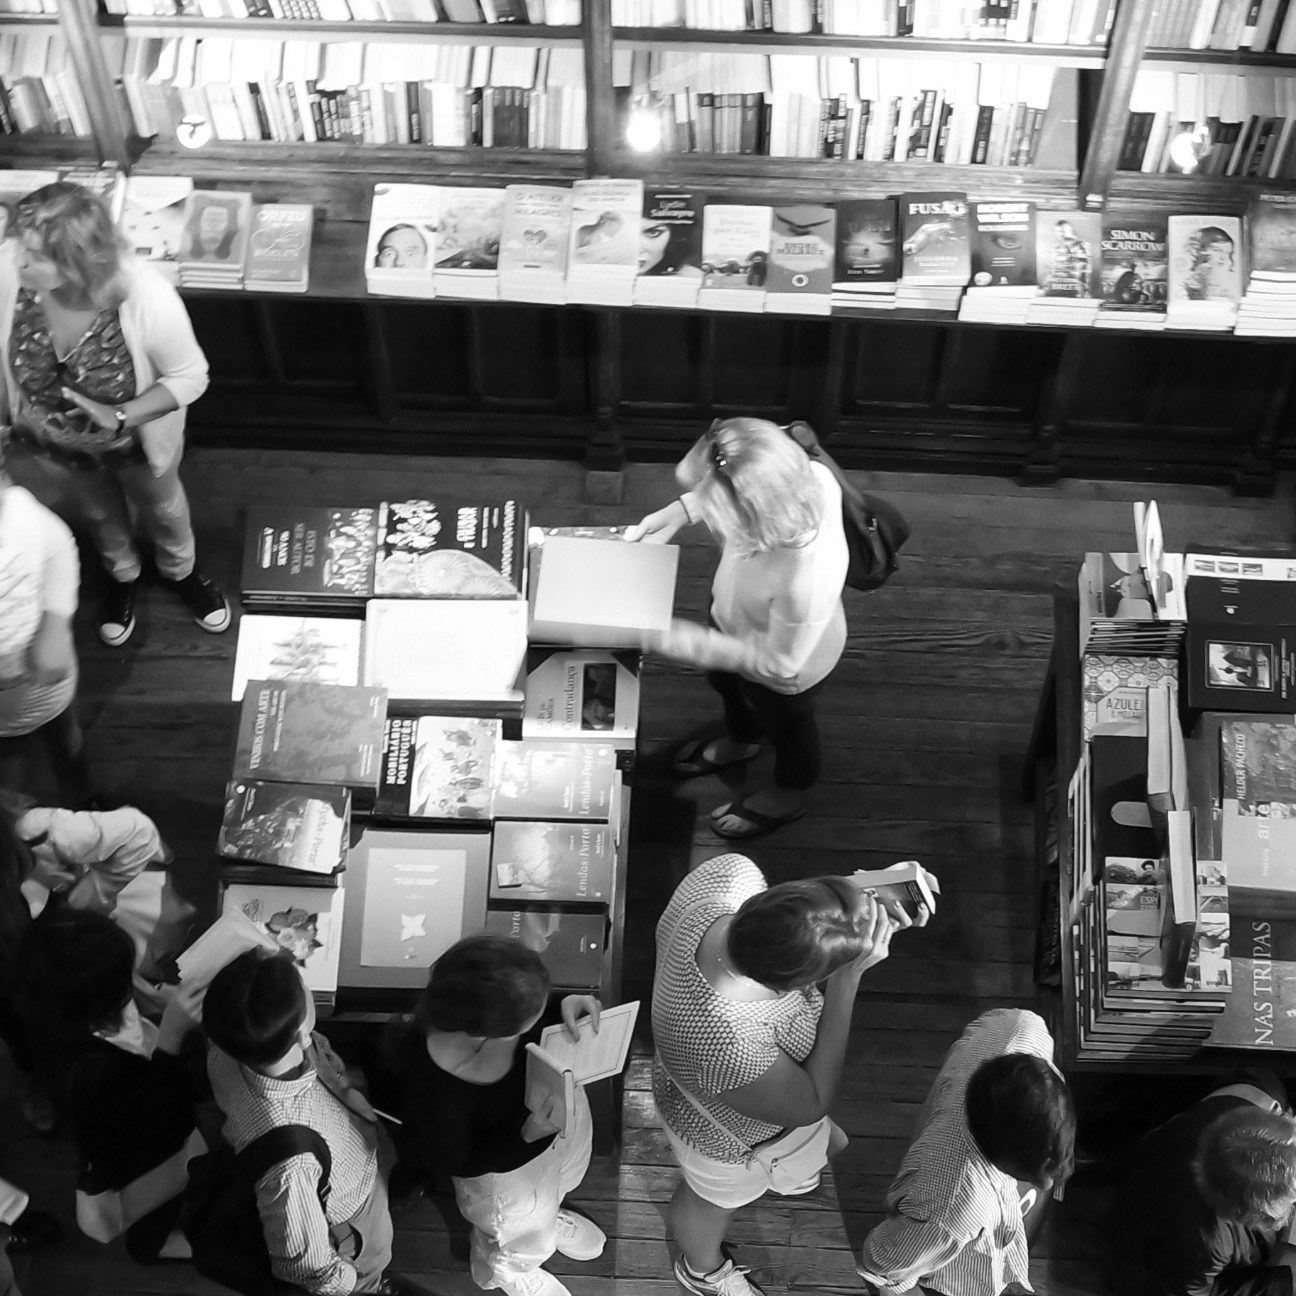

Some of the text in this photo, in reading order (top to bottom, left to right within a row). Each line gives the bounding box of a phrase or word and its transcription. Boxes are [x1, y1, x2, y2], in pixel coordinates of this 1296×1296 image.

[1101, 240, 1167, 252] SCARROW
[1110, 230, 1156, 241] SIMON
[562, 664, 579, 732] Contradança
[385, 720, 402, 785] MOBILIÁRIO
[396, 720, 413, 786] PORTUGUÊS
[1234, 733, 1247, 800] HELDER PACHECO
[575, 827, 591, 898] Lendas Porto
[1251, 919, 1275, 1047] NAS TRIPAS
